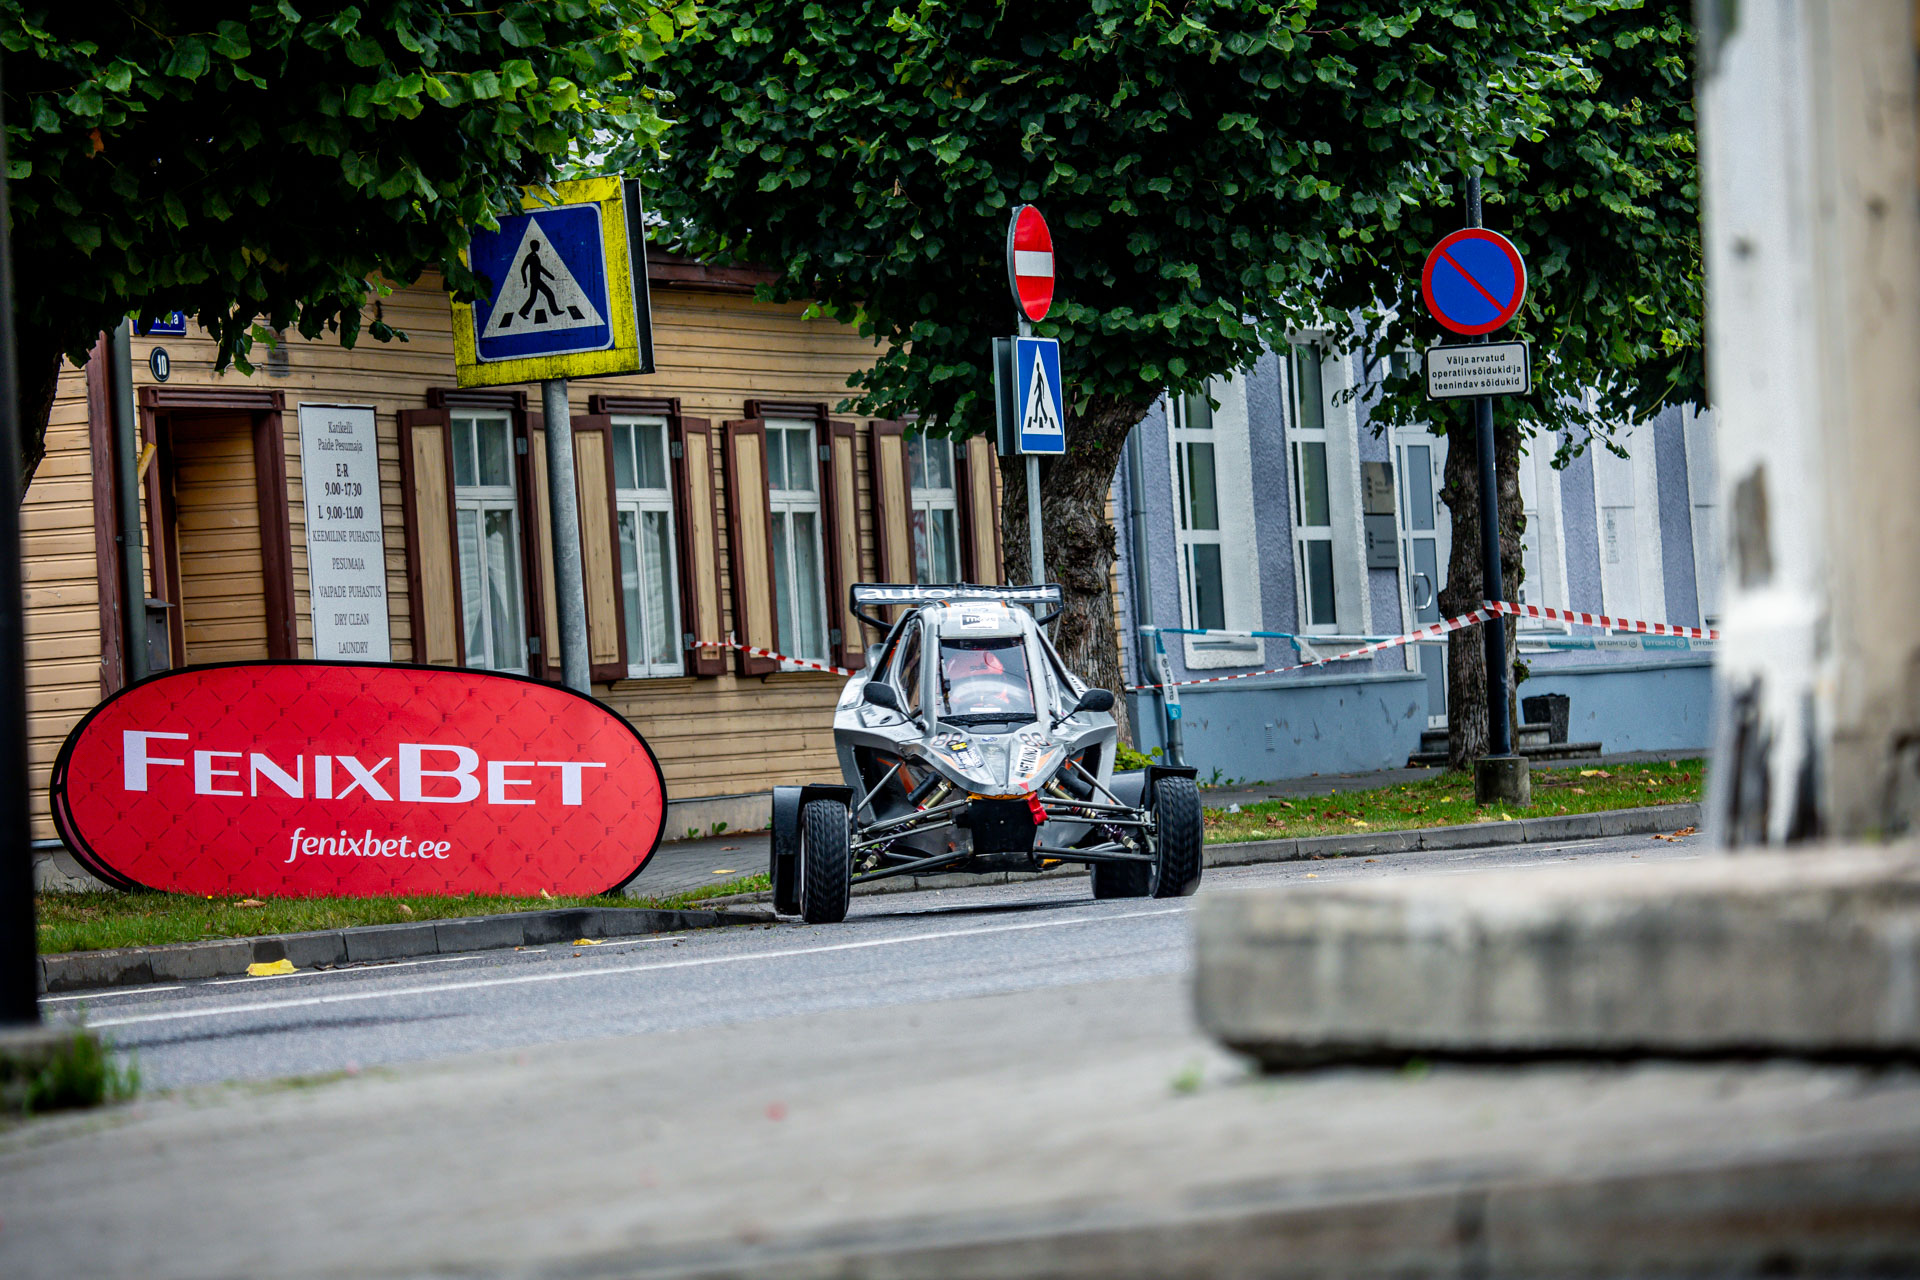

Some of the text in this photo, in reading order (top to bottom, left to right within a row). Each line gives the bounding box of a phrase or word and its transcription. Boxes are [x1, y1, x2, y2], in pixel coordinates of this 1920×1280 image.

[157, 354, 168, 376] 10
[1446, 353, 1505, 366] Välja arvatud
[1432, 366, 1511, 379] operatiivsõidukid
[1434, 377, 1520, 391] teenindav sõidukid
[318, 438, 363, 454] Paide Pesumaja
[336, 463, 349, 477] E-R
[325, 482, 362, 497] 9.00-17.30
[318, 504, 364, 520] L 9.00-11.00
[312, 530, 381, 542] KEEMILINE PUHASTUS
[332, 558, 365, 571] PESUMAJA
[319, 586, 382, 598] VAIPADE PUHASTUS
[334, 613, 369, 625] DRY CLEAN
[338, 641, 368, 654] LAUNDRY
[284, 827, 451, 863] fenixbet.ee
